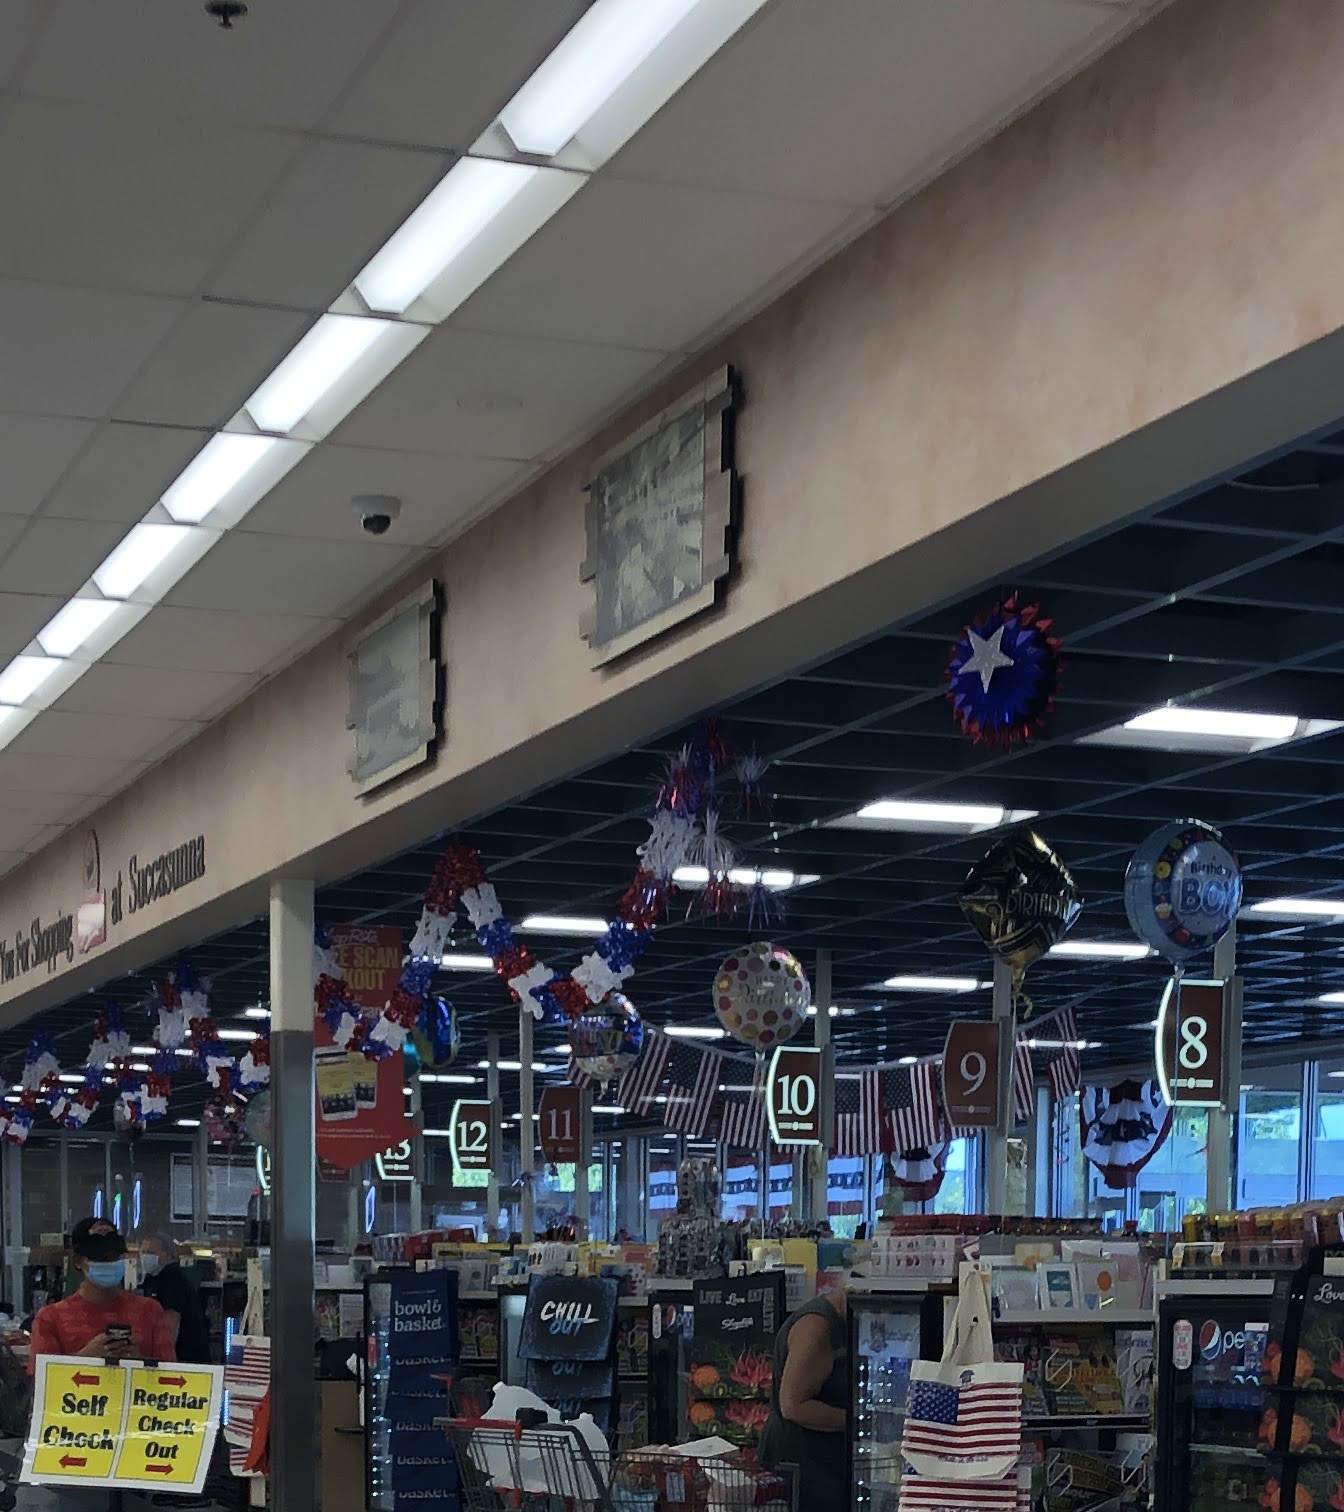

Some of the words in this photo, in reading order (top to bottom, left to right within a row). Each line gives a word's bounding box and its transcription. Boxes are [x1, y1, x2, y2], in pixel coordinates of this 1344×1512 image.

[111, 870, 123, 925] at
[129, 835, 206, 914] Succasunna
[0, 939, 15, 985] You
[31, 910, 74, 974] Shopping
[353, 946, 399, 968] SCAN
[345, 968, 386, 991] KOUT
[1179, 1016, 1208, 1069] 8
[960, 1050, 988, 1095] 9
[777, 1074, 817, 1116] 10
[457, 1120, 488, 1152] 12
[546, 1109, 573, 1141] 11
[540, 1300, 600, 1324] CHILL
[549, 1318, 584, 1337] OUT
[61, 1393, 109, 1417] Self
[133, 1388, 208, 1412] Regular
[43, 1425, 114, 1451] Check
[138, 1415, 196, 1436] Check
[145, 1441, 180, 1460] Out
